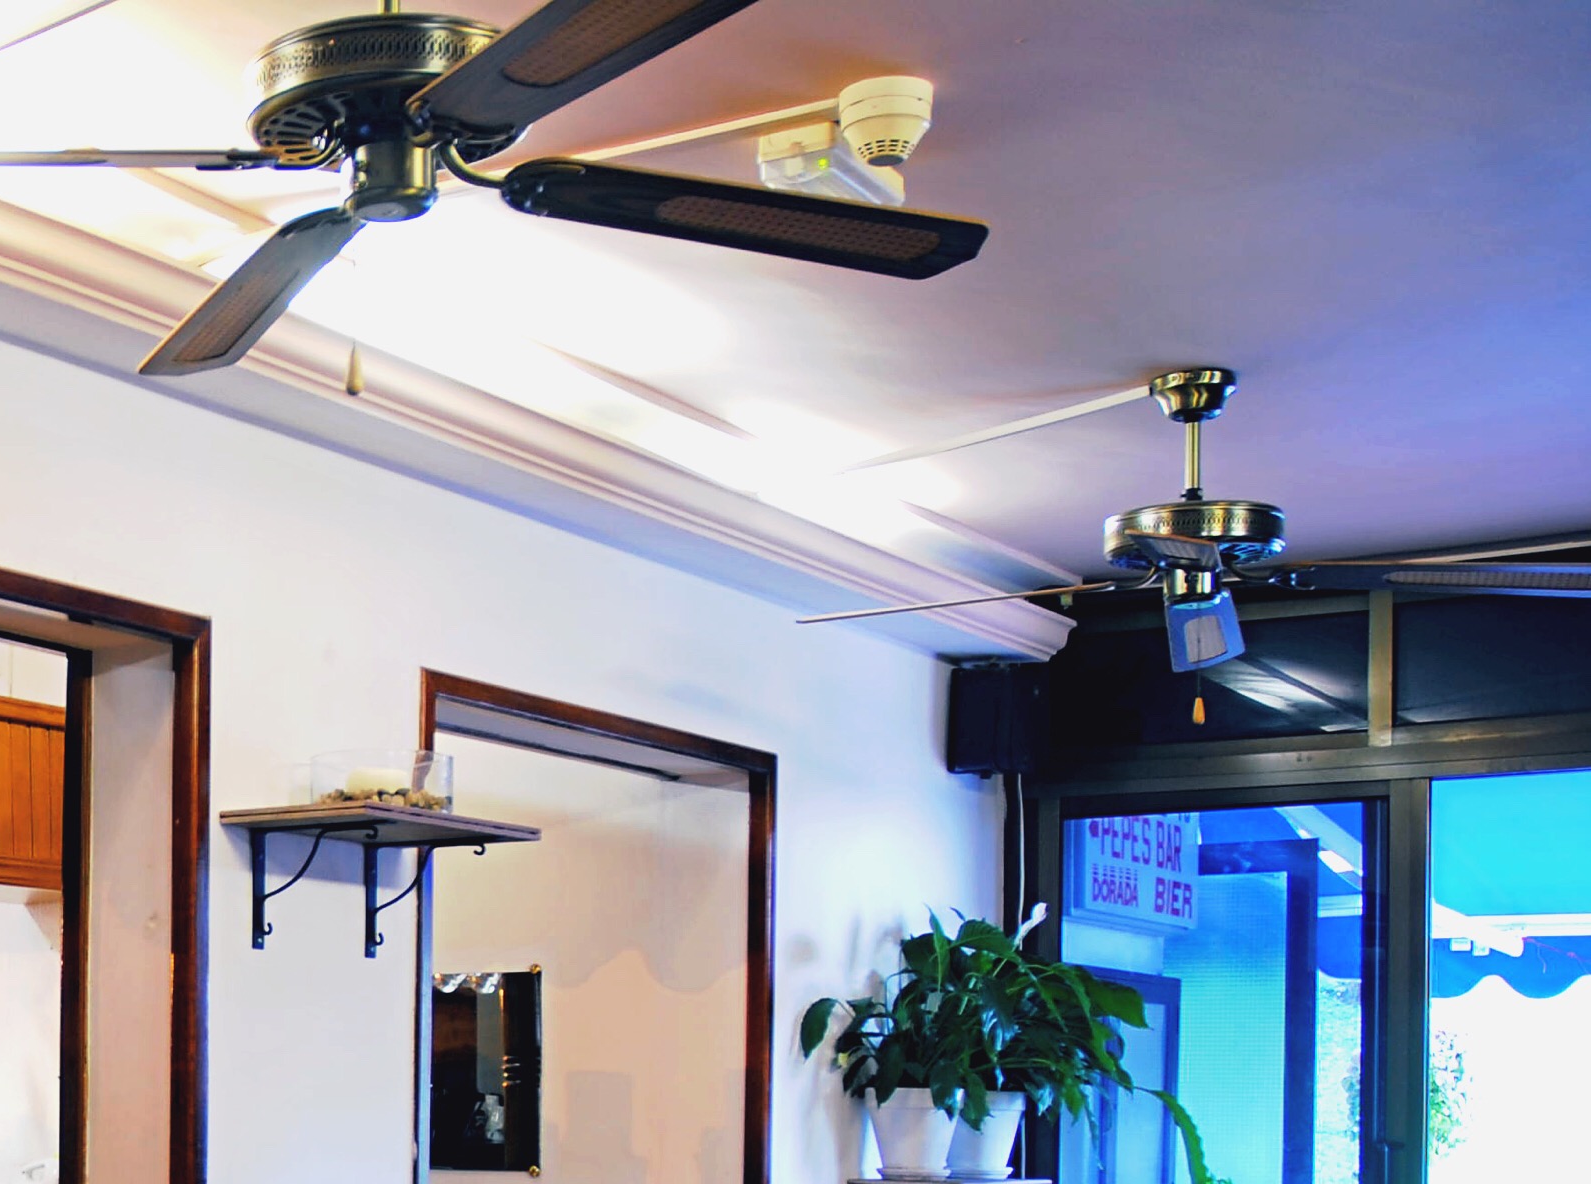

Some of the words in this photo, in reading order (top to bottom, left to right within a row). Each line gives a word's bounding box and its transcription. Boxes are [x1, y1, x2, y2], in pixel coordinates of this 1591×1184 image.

[1100, 816, 1151, 866] PEPES
[1155, 820, 1182, 873] BAR
[1091, 875, 1139, 907] DORADA
[1153, 876, 1193, 920] BIER
